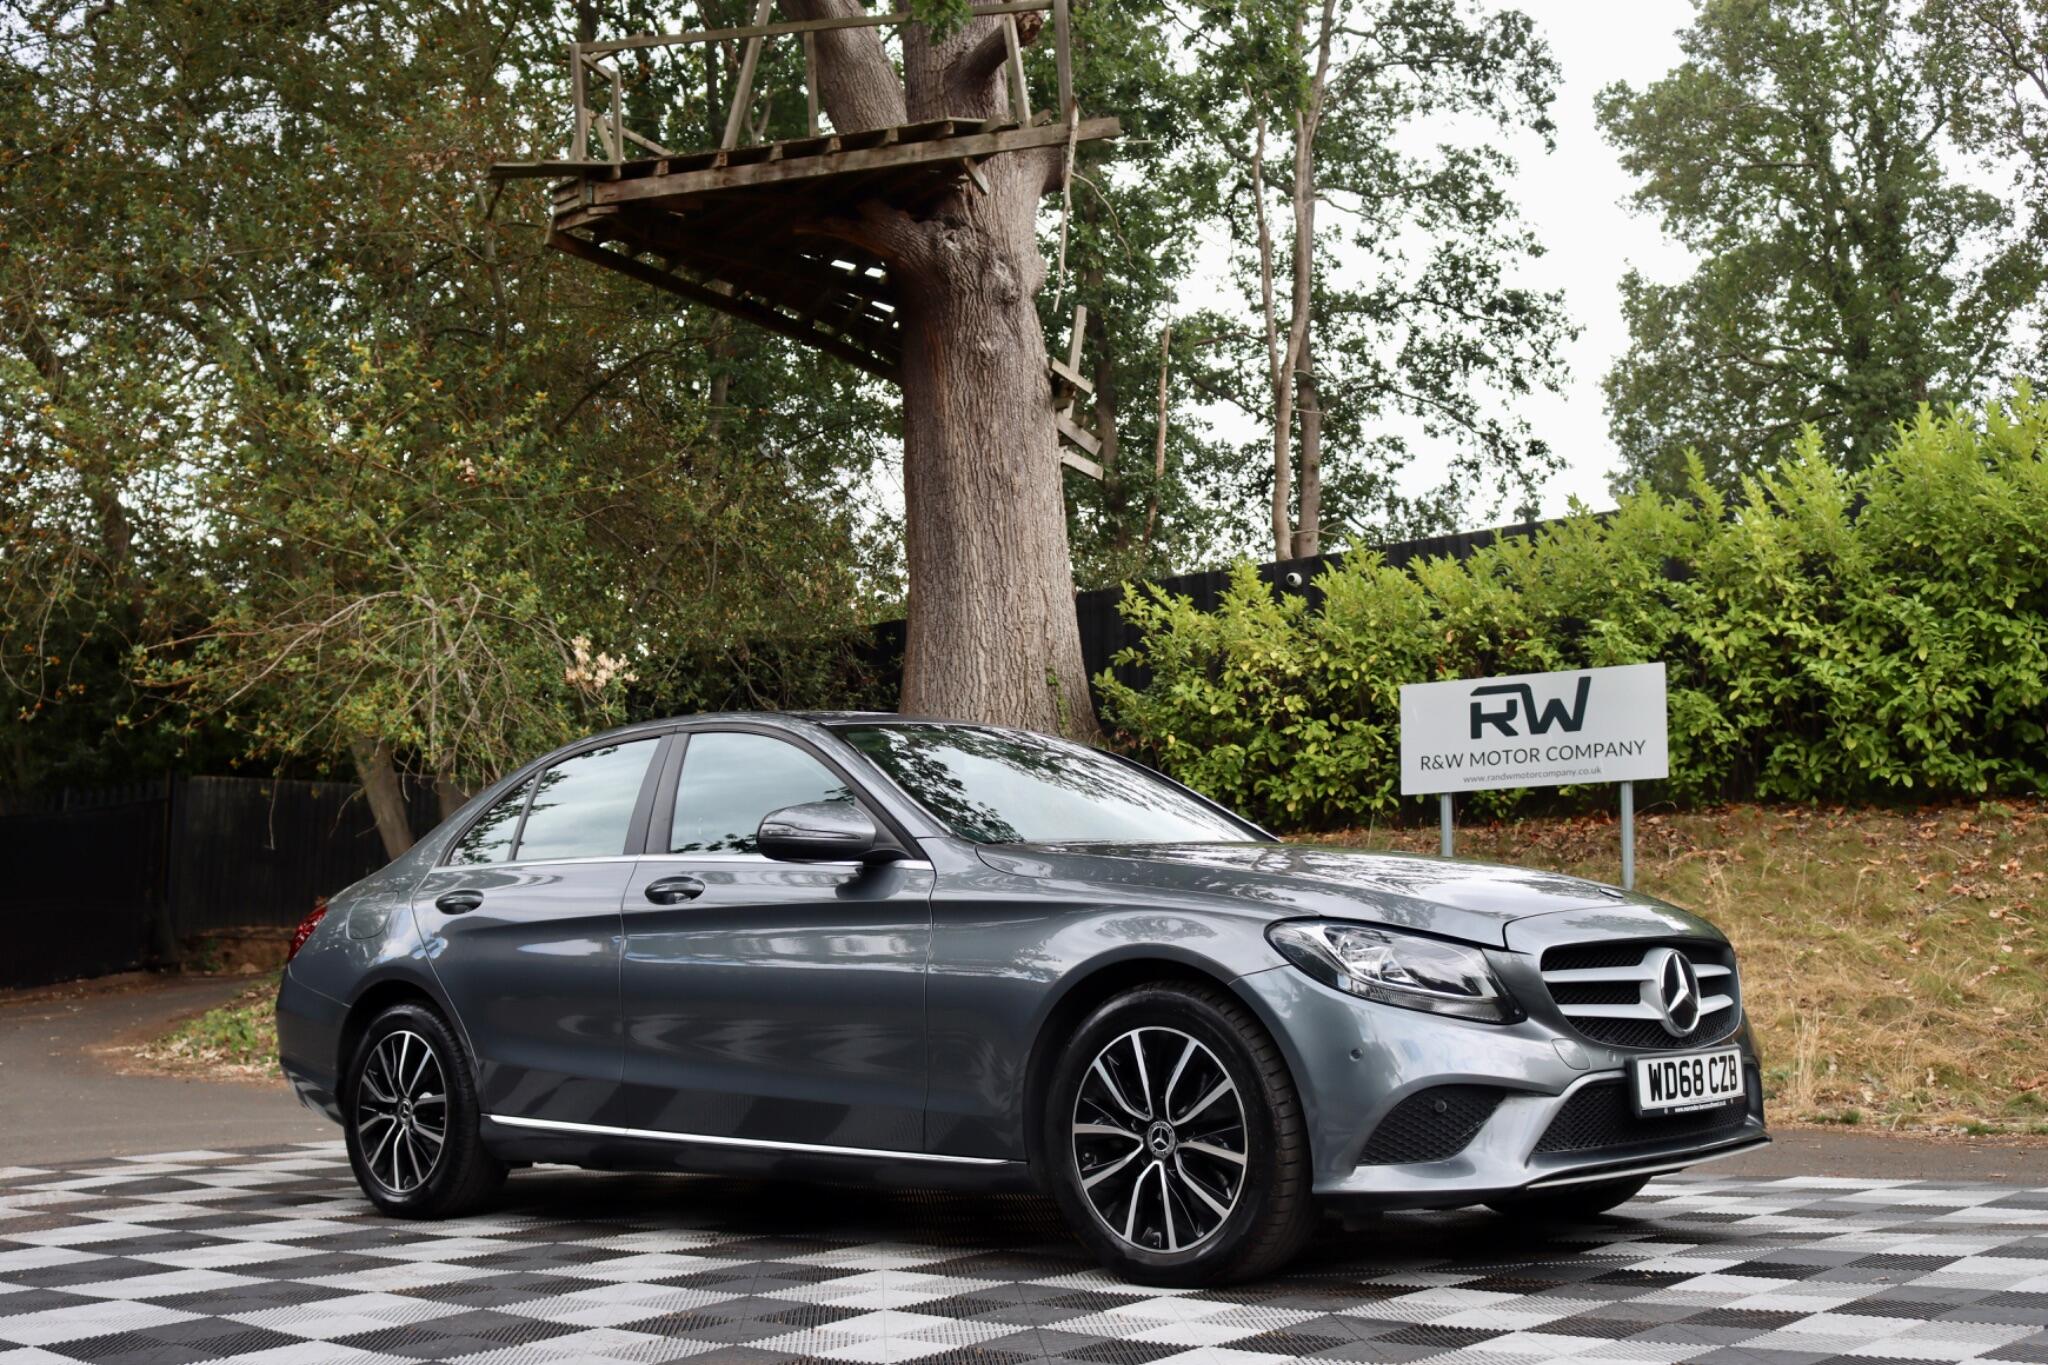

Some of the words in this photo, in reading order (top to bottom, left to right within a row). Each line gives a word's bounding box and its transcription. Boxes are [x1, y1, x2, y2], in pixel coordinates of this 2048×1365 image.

[1470, 677, 1591, 739] RW
[1421, 752, 1464, 770] R&W
[1469, 747, 1540, 768] MOTOR
[1546, 740, 1646, 761] COMPANY
[1463, 766, 1602, 783] www.randwmotorcompany.co.uk
[1648, 1059, 1703, 1101] WD68
[1709, 1055, 1737, 1093] CZB
